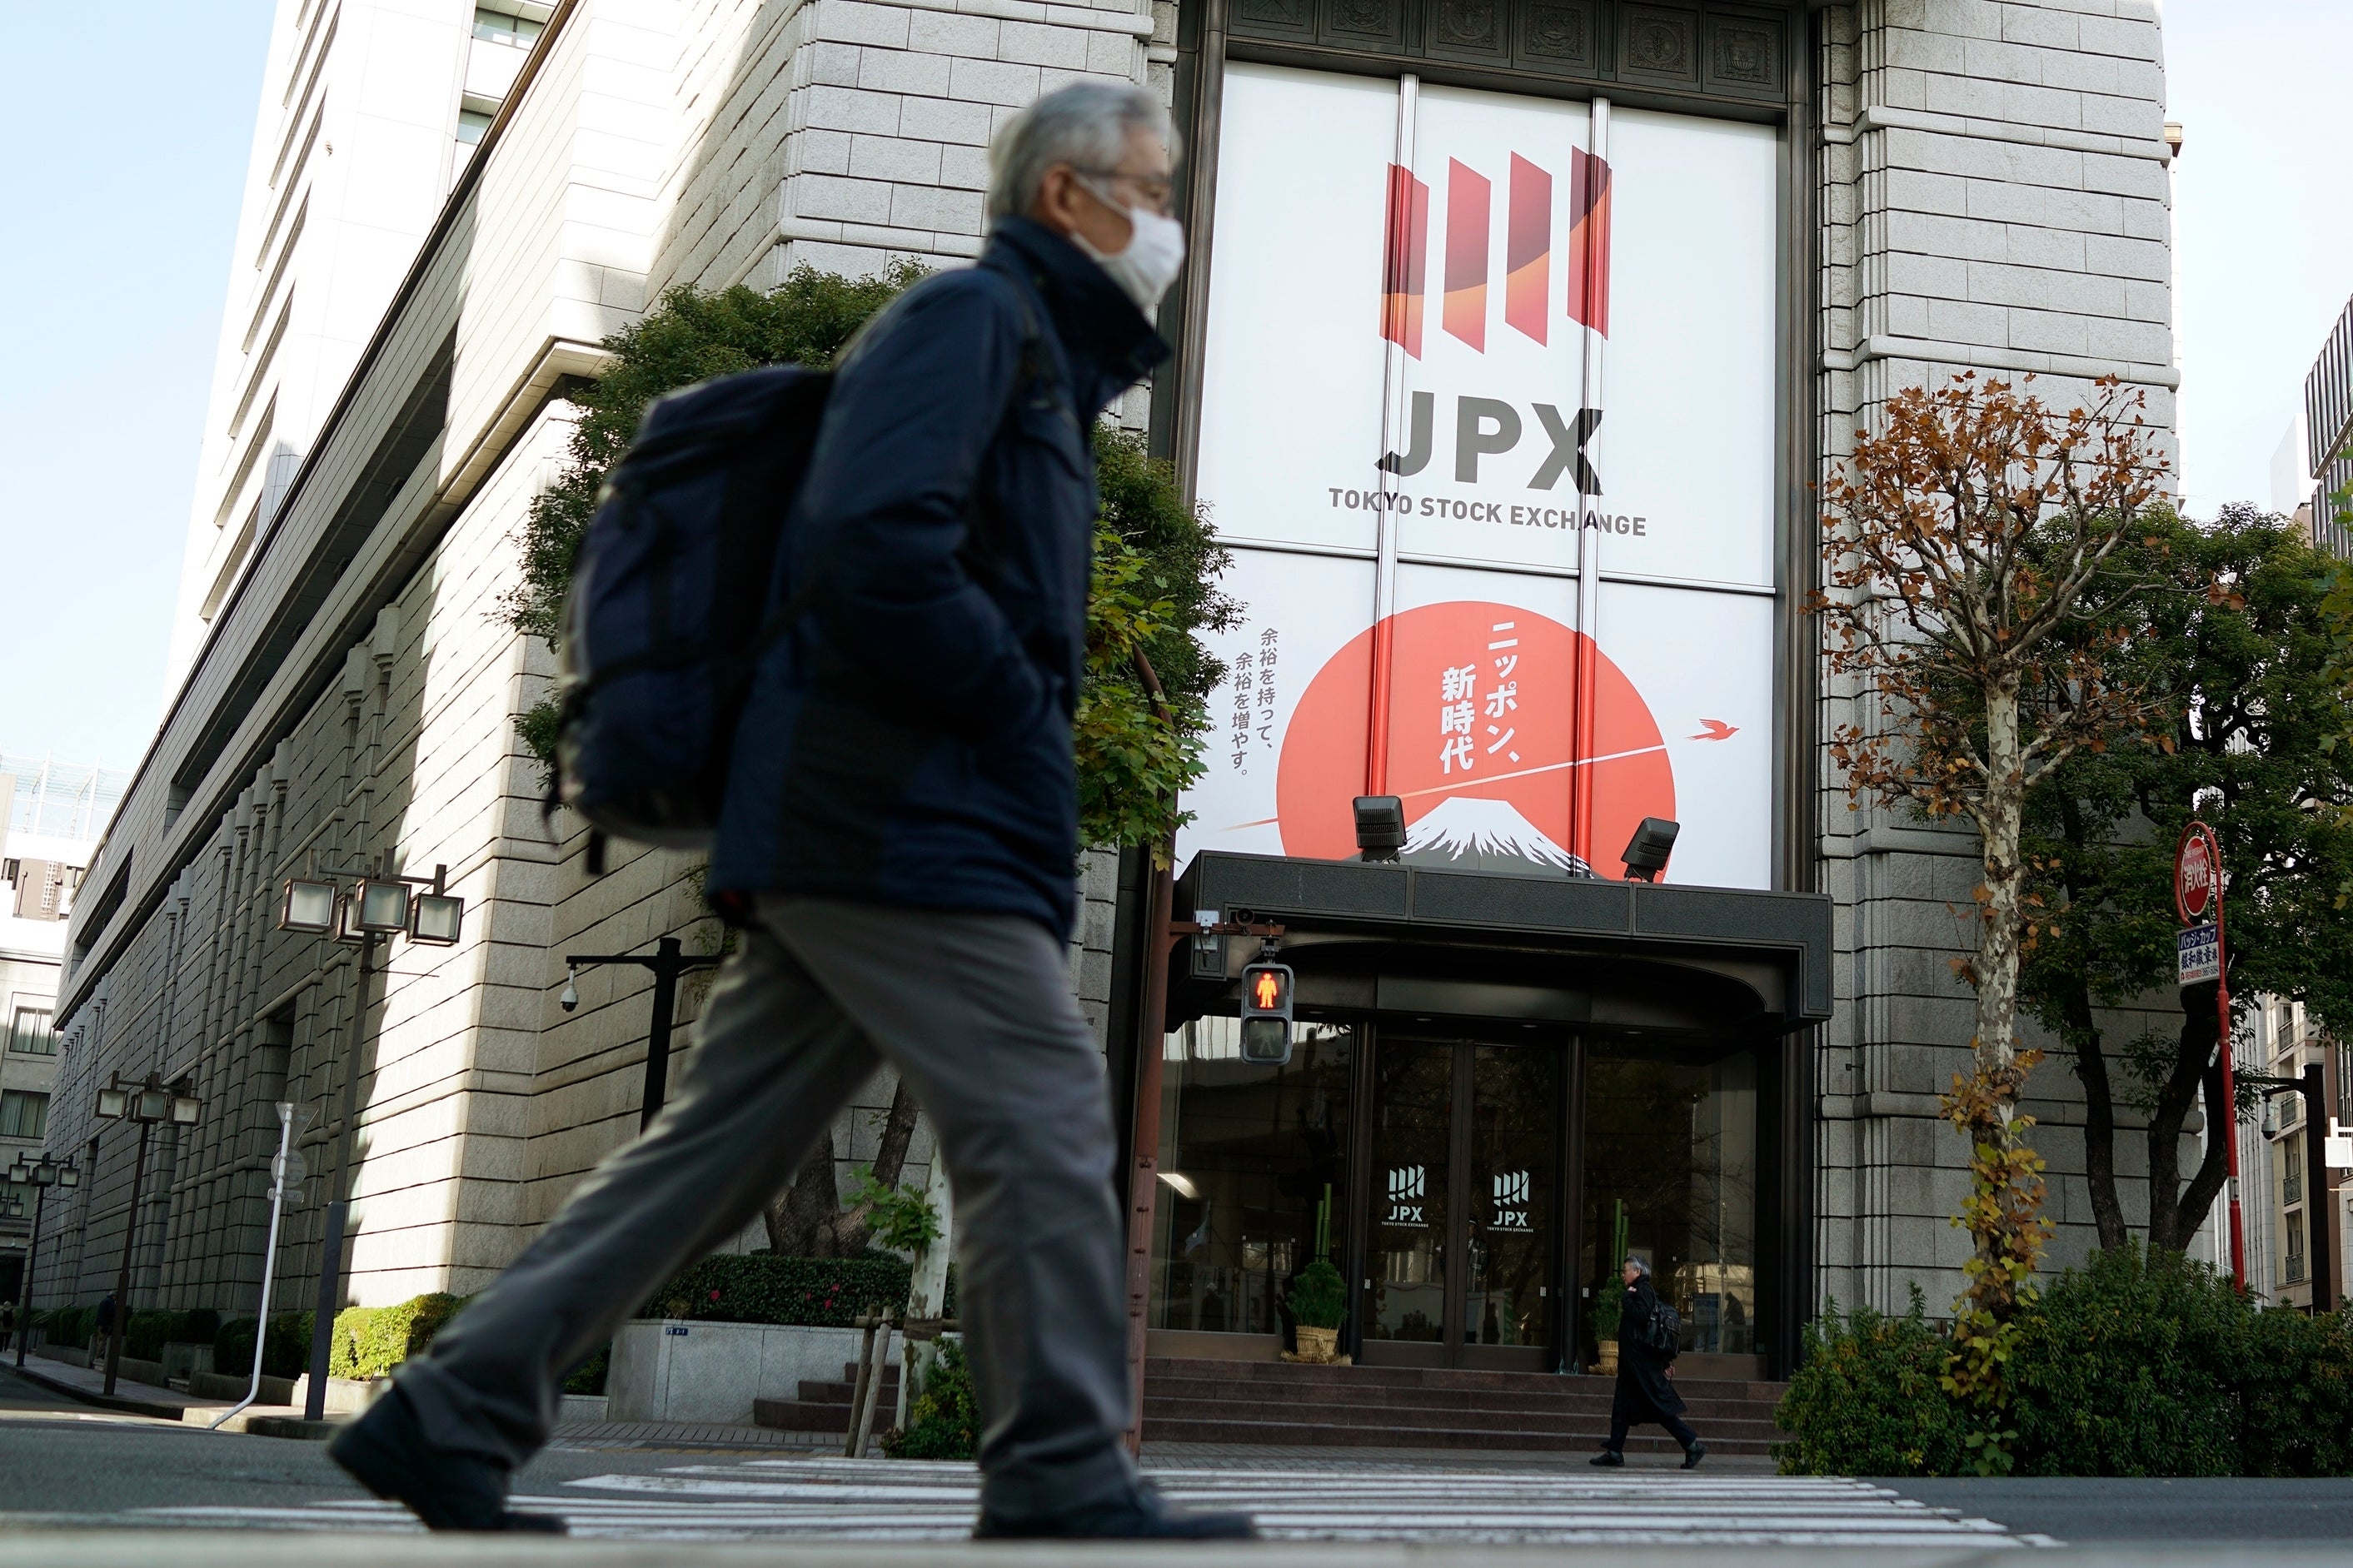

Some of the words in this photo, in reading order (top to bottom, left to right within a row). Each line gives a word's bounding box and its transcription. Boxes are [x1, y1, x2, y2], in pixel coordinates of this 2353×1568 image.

[1373, 391, 1604, 496] JPX
[1329, 487, 1413, 515] TOKYO
[1419, 497, 1503, 524] STOCK
[1509, 505, 1647, 537] EXCHANGE
[1230, 651, 1254, 776] 余裕を増やす。
[1256, 627, 1279, 749] 余裕を持って、
[1438, 663, 1477, 774] 新時代
[1483, 620, 1520, 763] ニッポン、
[2184, 858, 2209, 894] 消火栓
[1388, 1205, 1423, 1222] JPX
[1493, 1210, 1528, 1227] JPX
